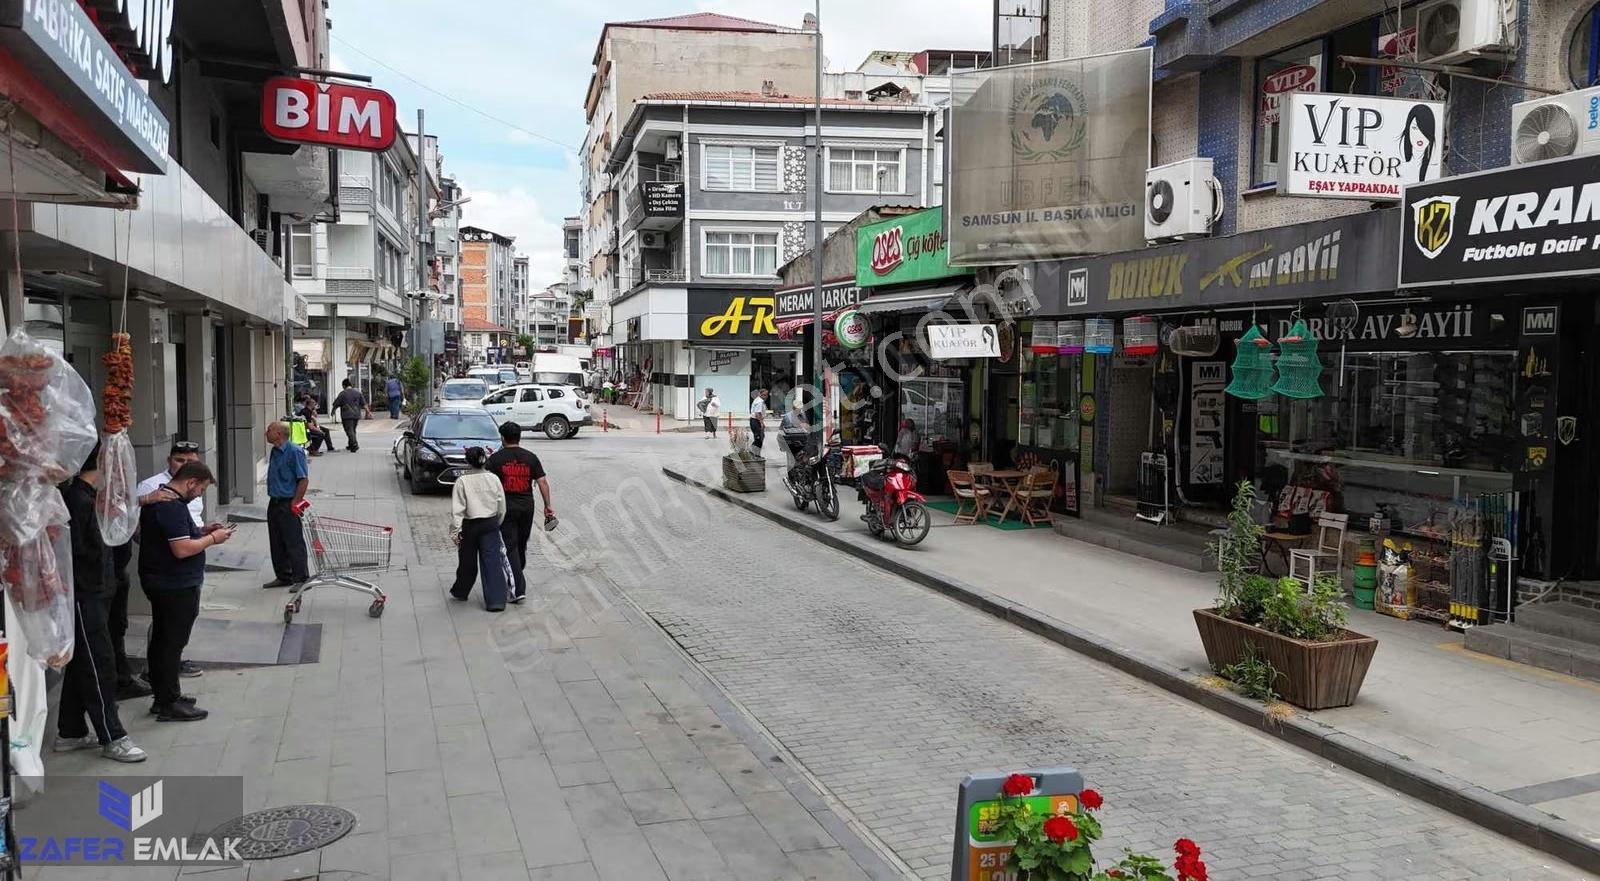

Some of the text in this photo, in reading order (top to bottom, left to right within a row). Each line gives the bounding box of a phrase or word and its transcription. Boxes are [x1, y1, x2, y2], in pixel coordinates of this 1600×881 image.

[1271, 69, 1307, 91] VIP
[95, 50, 125, 124] SATIŞ
[126, 87, 169, 161] MAĞAZASI
[276, 83, 381, 138] BİM
[1588, 97, 1598, 129] beko
[1304, 98, 1382, 147] VIP
[1294, 151, 1402, 178] KUAFÖR
[1309, 180, 1400, 195] EŞAY YAPRAKDAL
[962, 204, 1136, 227] SAMSUN İL BAŞKANLIĞI
[907, 236, 920, 261] Çiğ
[1462, 241, 1537, 262] Futbola
[1541, 235, 1588, 255] Dair
[1108, 254, 1189, 300] DORUK
[1249, 258, 1274, 289] AV
[780, 286, 862, 313] MERAM ARKET
[938, 326, 967, 339] VIP
[1360, 314, 1393, 340] AV
